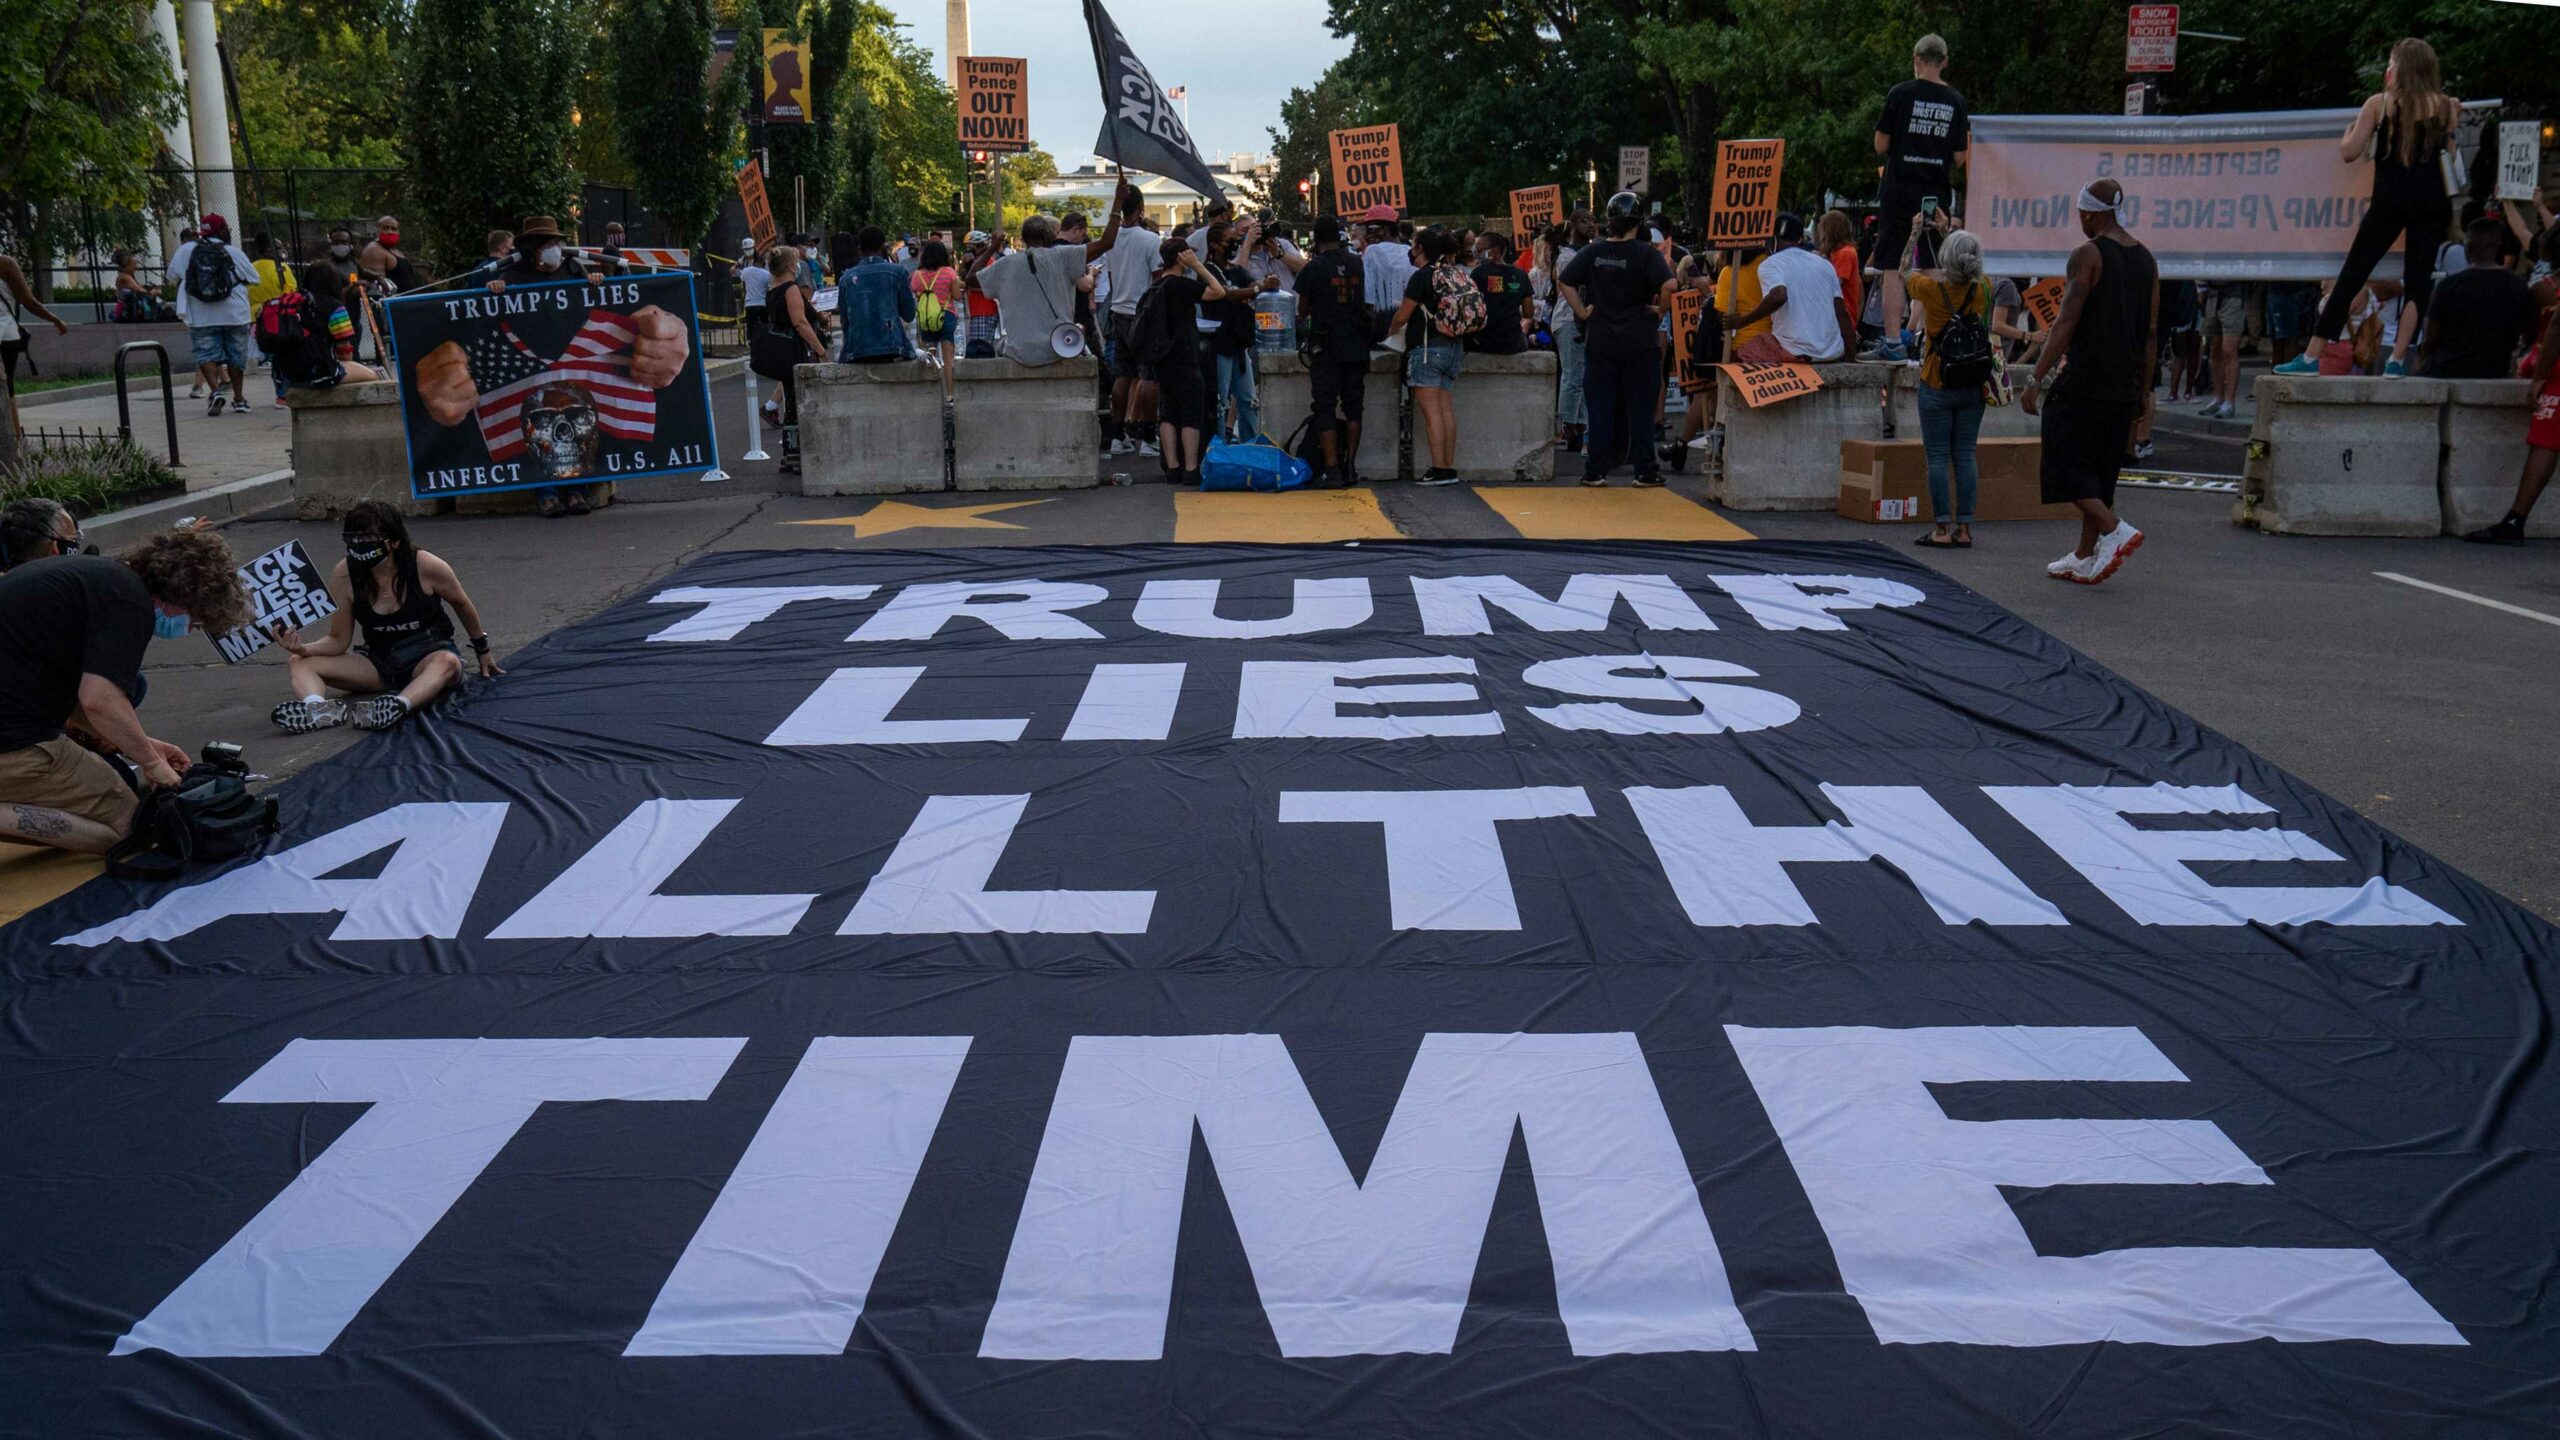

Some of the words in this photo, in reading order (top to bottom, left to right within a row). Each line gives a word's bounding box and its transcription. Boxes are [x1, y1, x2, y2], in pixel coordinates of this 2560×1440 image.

[2131, 18, 2175, 26] EMERGENCY
[2139, 8, 2170, 18] SNOW
[2135, 26, 2172, 36] ROUTE
[2131, 38, 2141, 46] NO
[2144, 38, 2174, 46] PARKING
[2139, 47, 2165, 55] DURING
[964, 60, 1021, 77] Trump/
[2129, 56, 2172, 64] EMERGENCY
[969, 75, 1017, 89] Pence
[971, 92, 1016, 114] OUT
[1912, 107, 1934, 119] MUST
[963, 117, 1024, 139] NOW!
[1336, 127, 1391, 147] Trump/
[1908, 123, 1932, 135] MUST
[1342, 146, 1389, 162] Pence
[1623, 151, 1645, 159] STOP
[1725, 142, 1779, 163] Trump/
[2508, 143, 2530, 162] FUCK
[1346, 161, 1389, 186] OUT
[1625, 168, 1641, 176] RED
[1726, 163, 1773, 179] Pence
[1340, 184, 1401, 212] NOW!
[1515, 187, 1555, 202] Trump/
[1725, 181, 1769, 208] OUT
[1519, 200, 1553, 213] Pence
[1712, 209, 1772, 236] NOW!
[445, 289, 568, 321] TRUMP'S
[583, 283, 640, 307] LIES
[1747, 367, 1797, 385] Pence
[1753, 378, 1811, 403] Trump/
[427, 463, 521, 489] INFECT
[606, 450, 656, 472] U.S.
[237, 543, 306, 592] ACK
[252, 572, 307, 617] VES
[645, 573, 1928, 643] TRUMP
[762, 650, 1802, 746] LIES
[52, 793, 1157, 947] ALL
[1278, 781, 2467, 931] THE
[107, 1025, 2470, 1360] TIME
